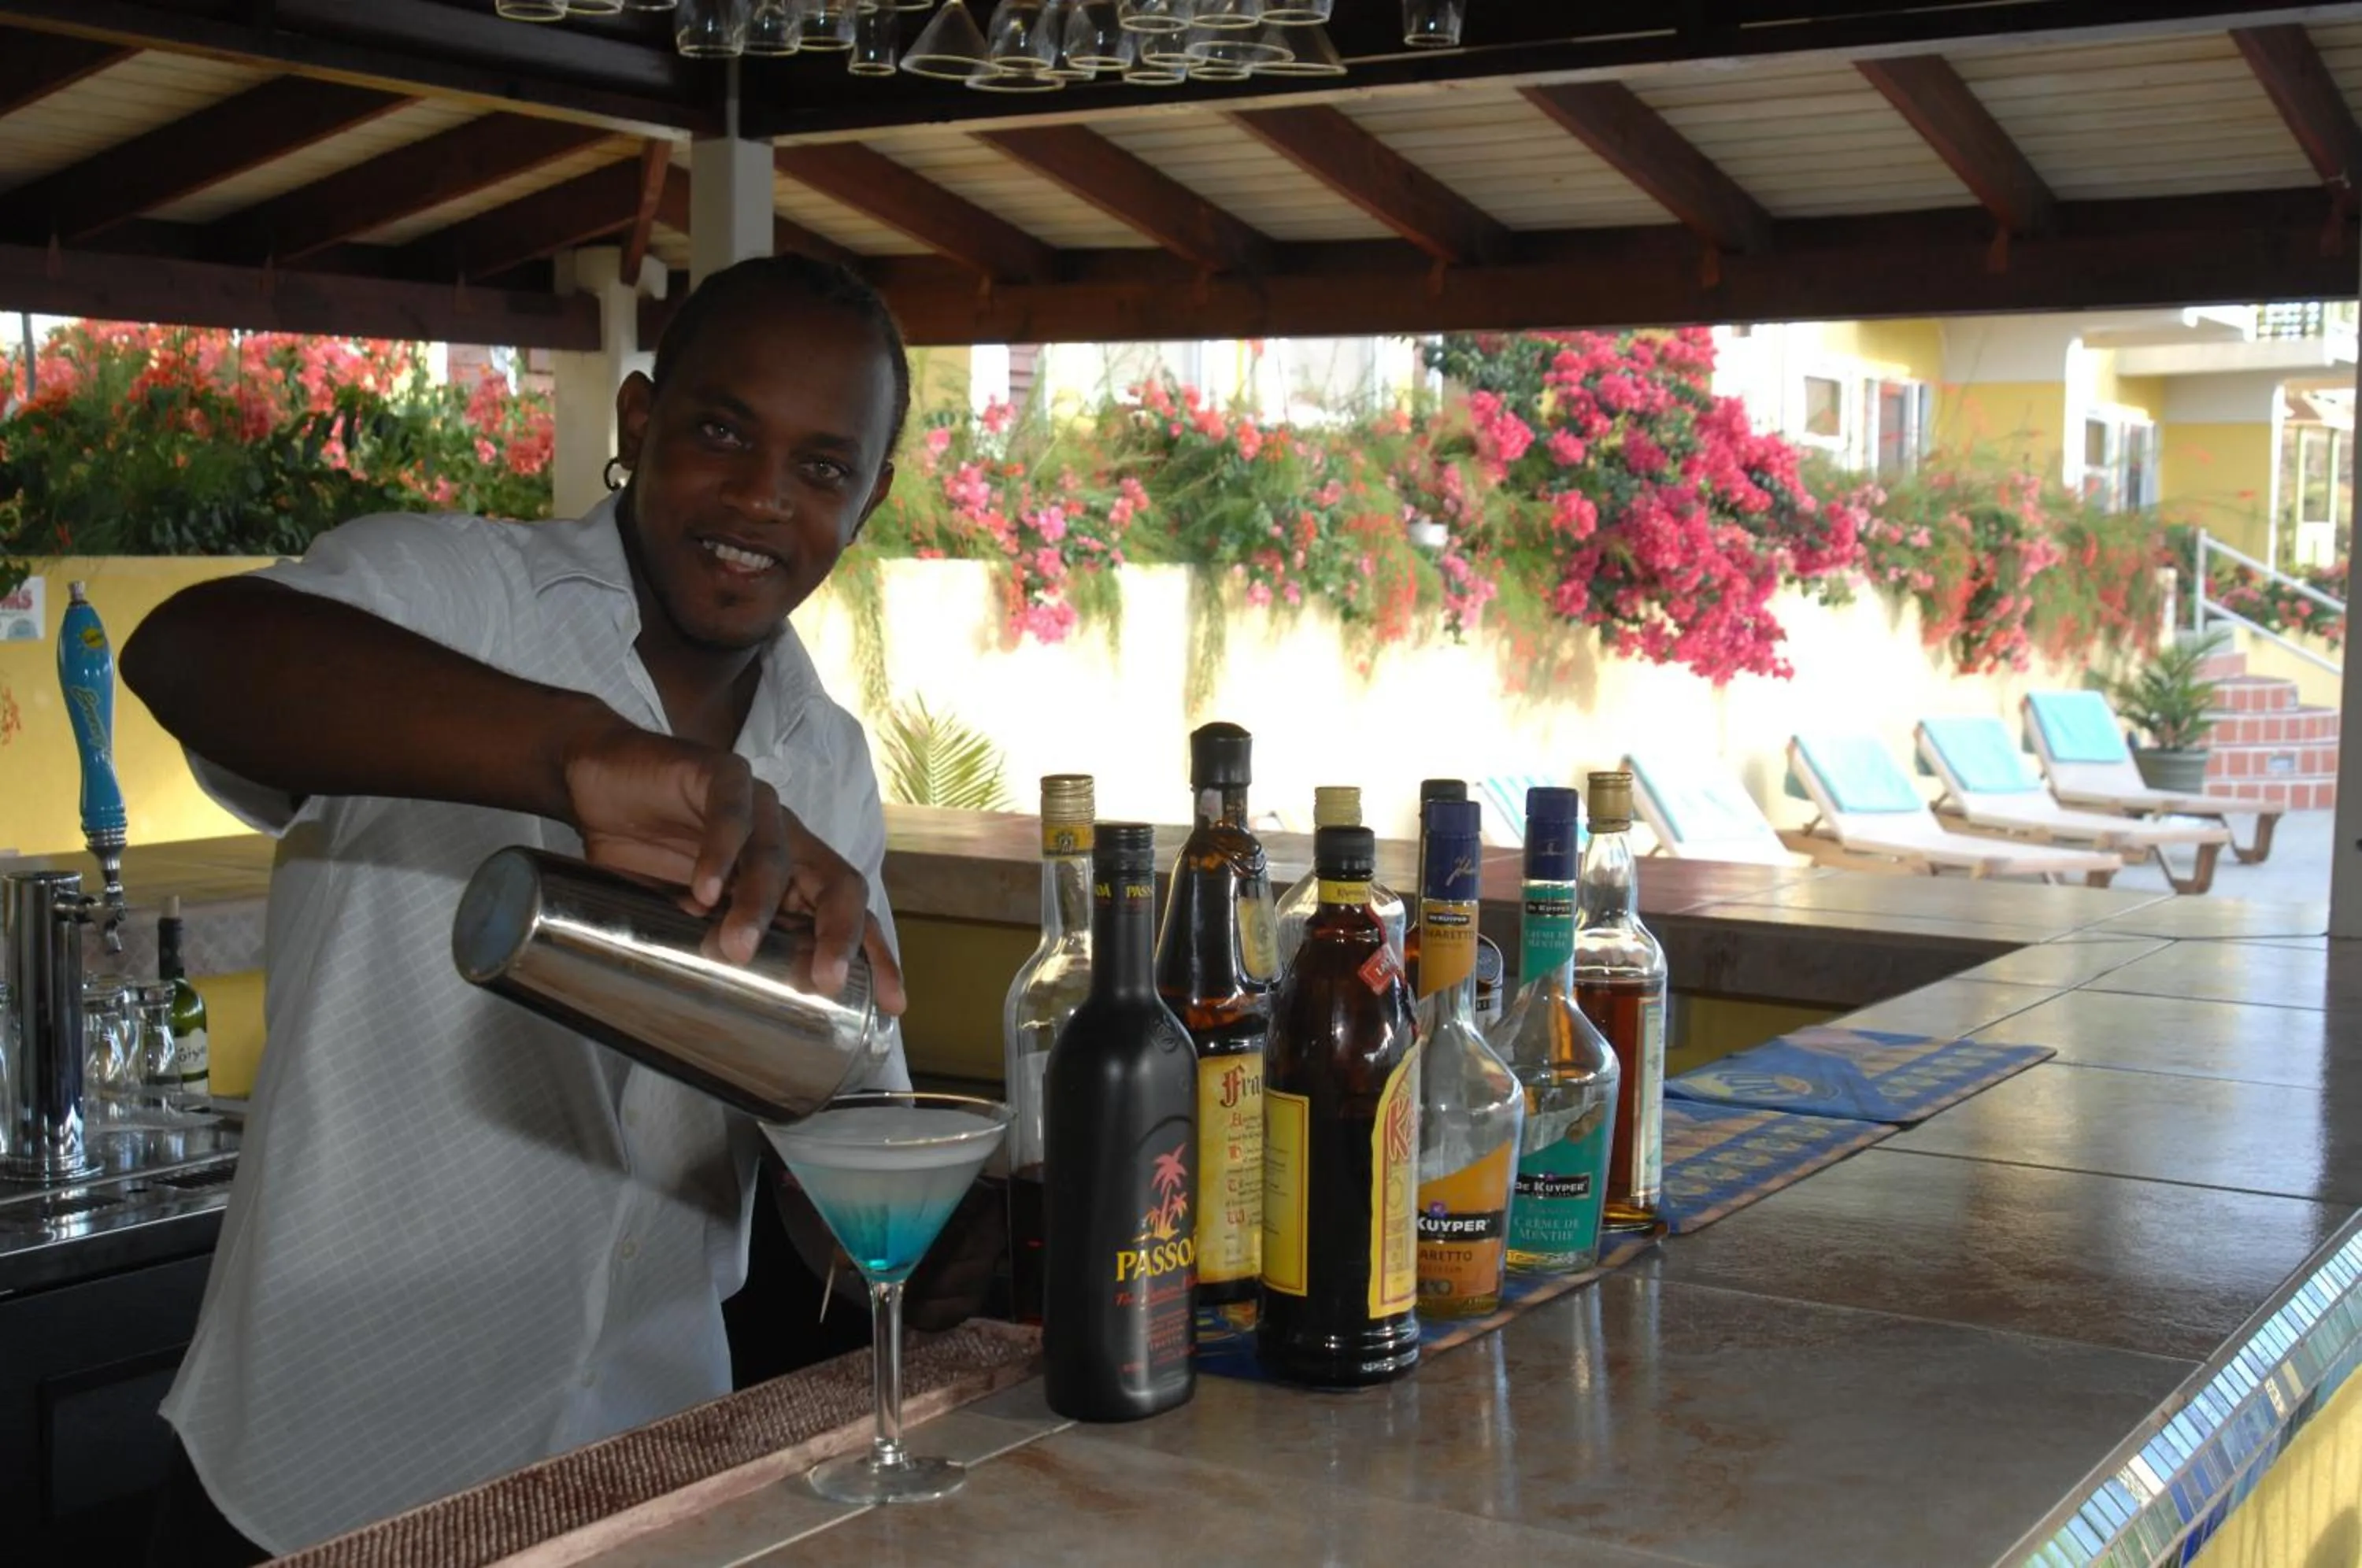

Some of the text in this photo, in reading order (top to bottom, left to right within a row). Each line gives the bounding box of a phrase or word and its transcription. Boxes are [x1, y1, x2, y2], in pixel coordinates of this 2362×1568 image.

[1534, 1182, 1585, 1193] KUYPER
[1417, 1217, 1486, 1233] KUYPER
[1519, 1229, 1574, 1242] MENTHE
[1116, 1237, 1195, 1282] PASSO
